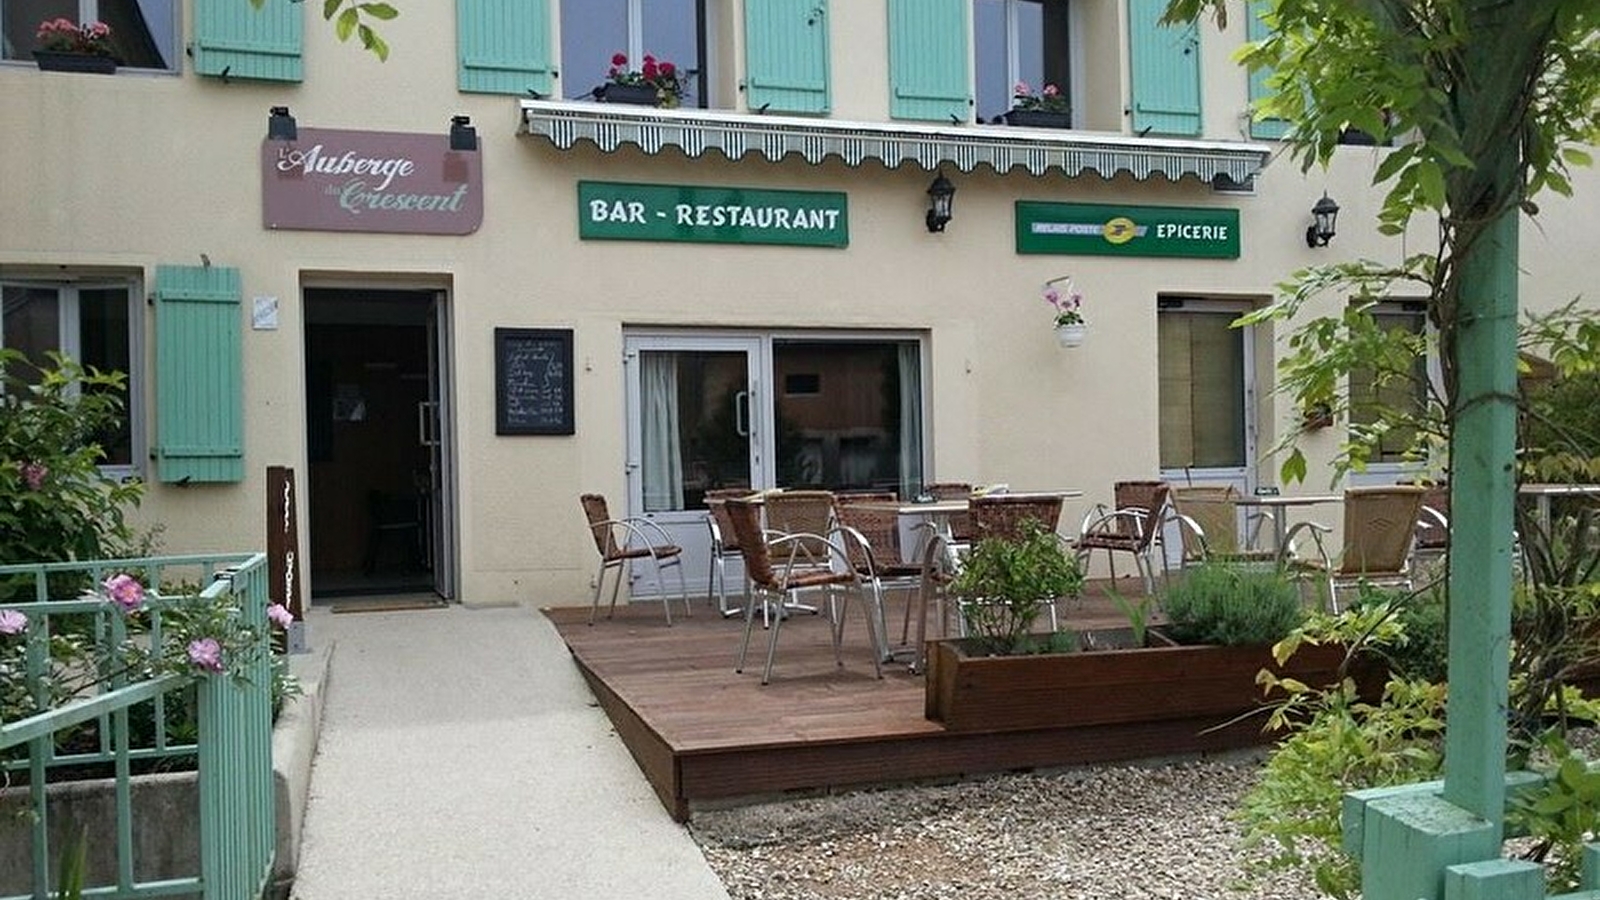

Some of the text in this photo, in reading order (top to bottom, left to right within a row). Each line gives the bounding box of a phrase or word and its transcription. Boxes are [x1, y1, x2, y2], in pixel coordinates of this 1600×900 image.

[340, 178, 468, 214] Crescent
[589, 200, 646, 224] BAR
[676, 204, 840, 230] RESTAURANT
[1156, 223, 1228, 240] EPICERIE
